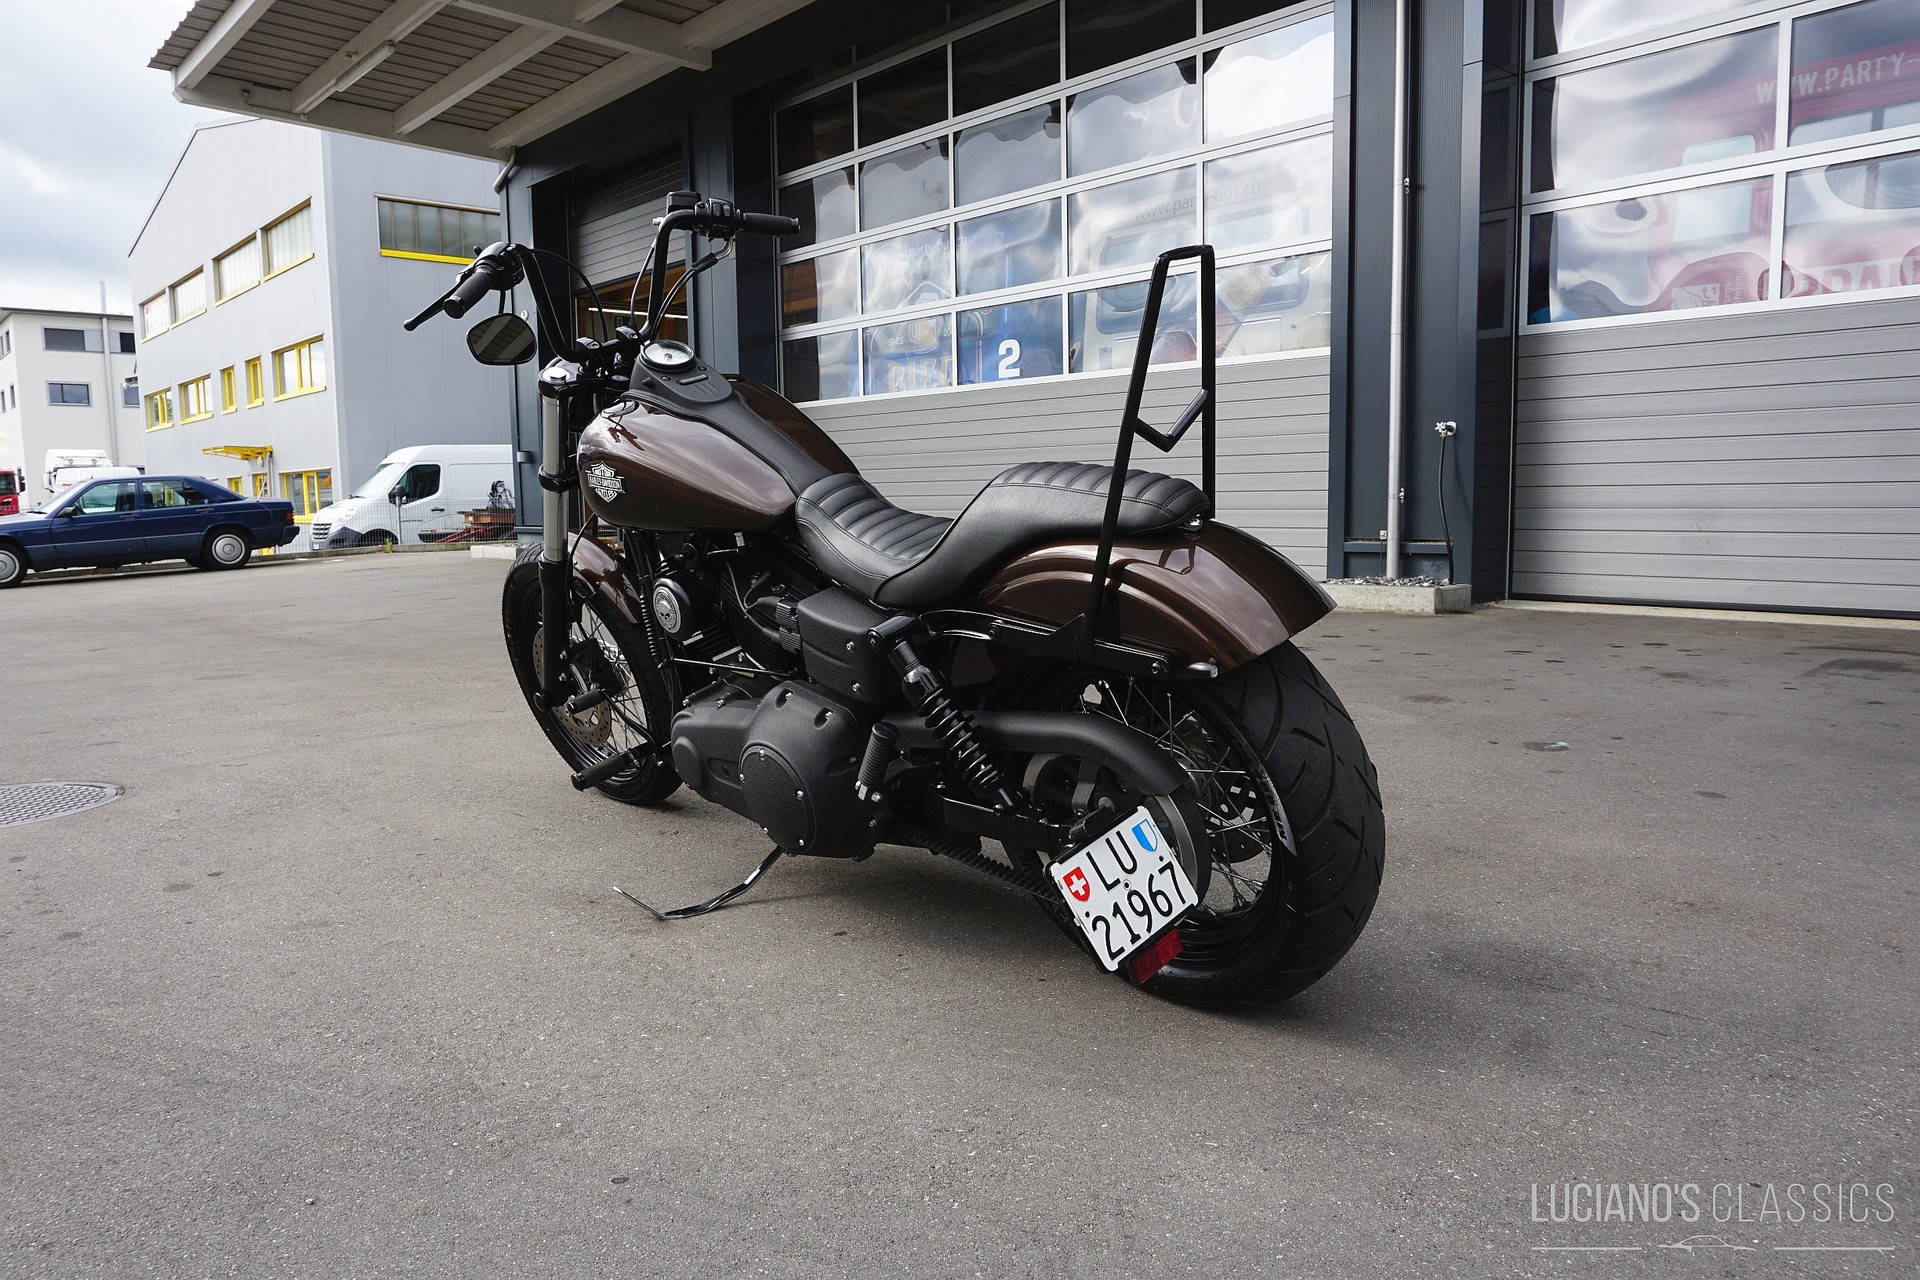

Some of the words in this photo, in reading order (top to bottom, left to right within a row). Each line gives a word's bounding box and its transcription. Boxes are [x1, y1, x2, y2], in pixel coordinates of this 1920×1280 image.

[998, 339, 1021, 378] 2
[1086, 830, 1137, 891] LU
[1092, 861, 1186, 960] 21967
